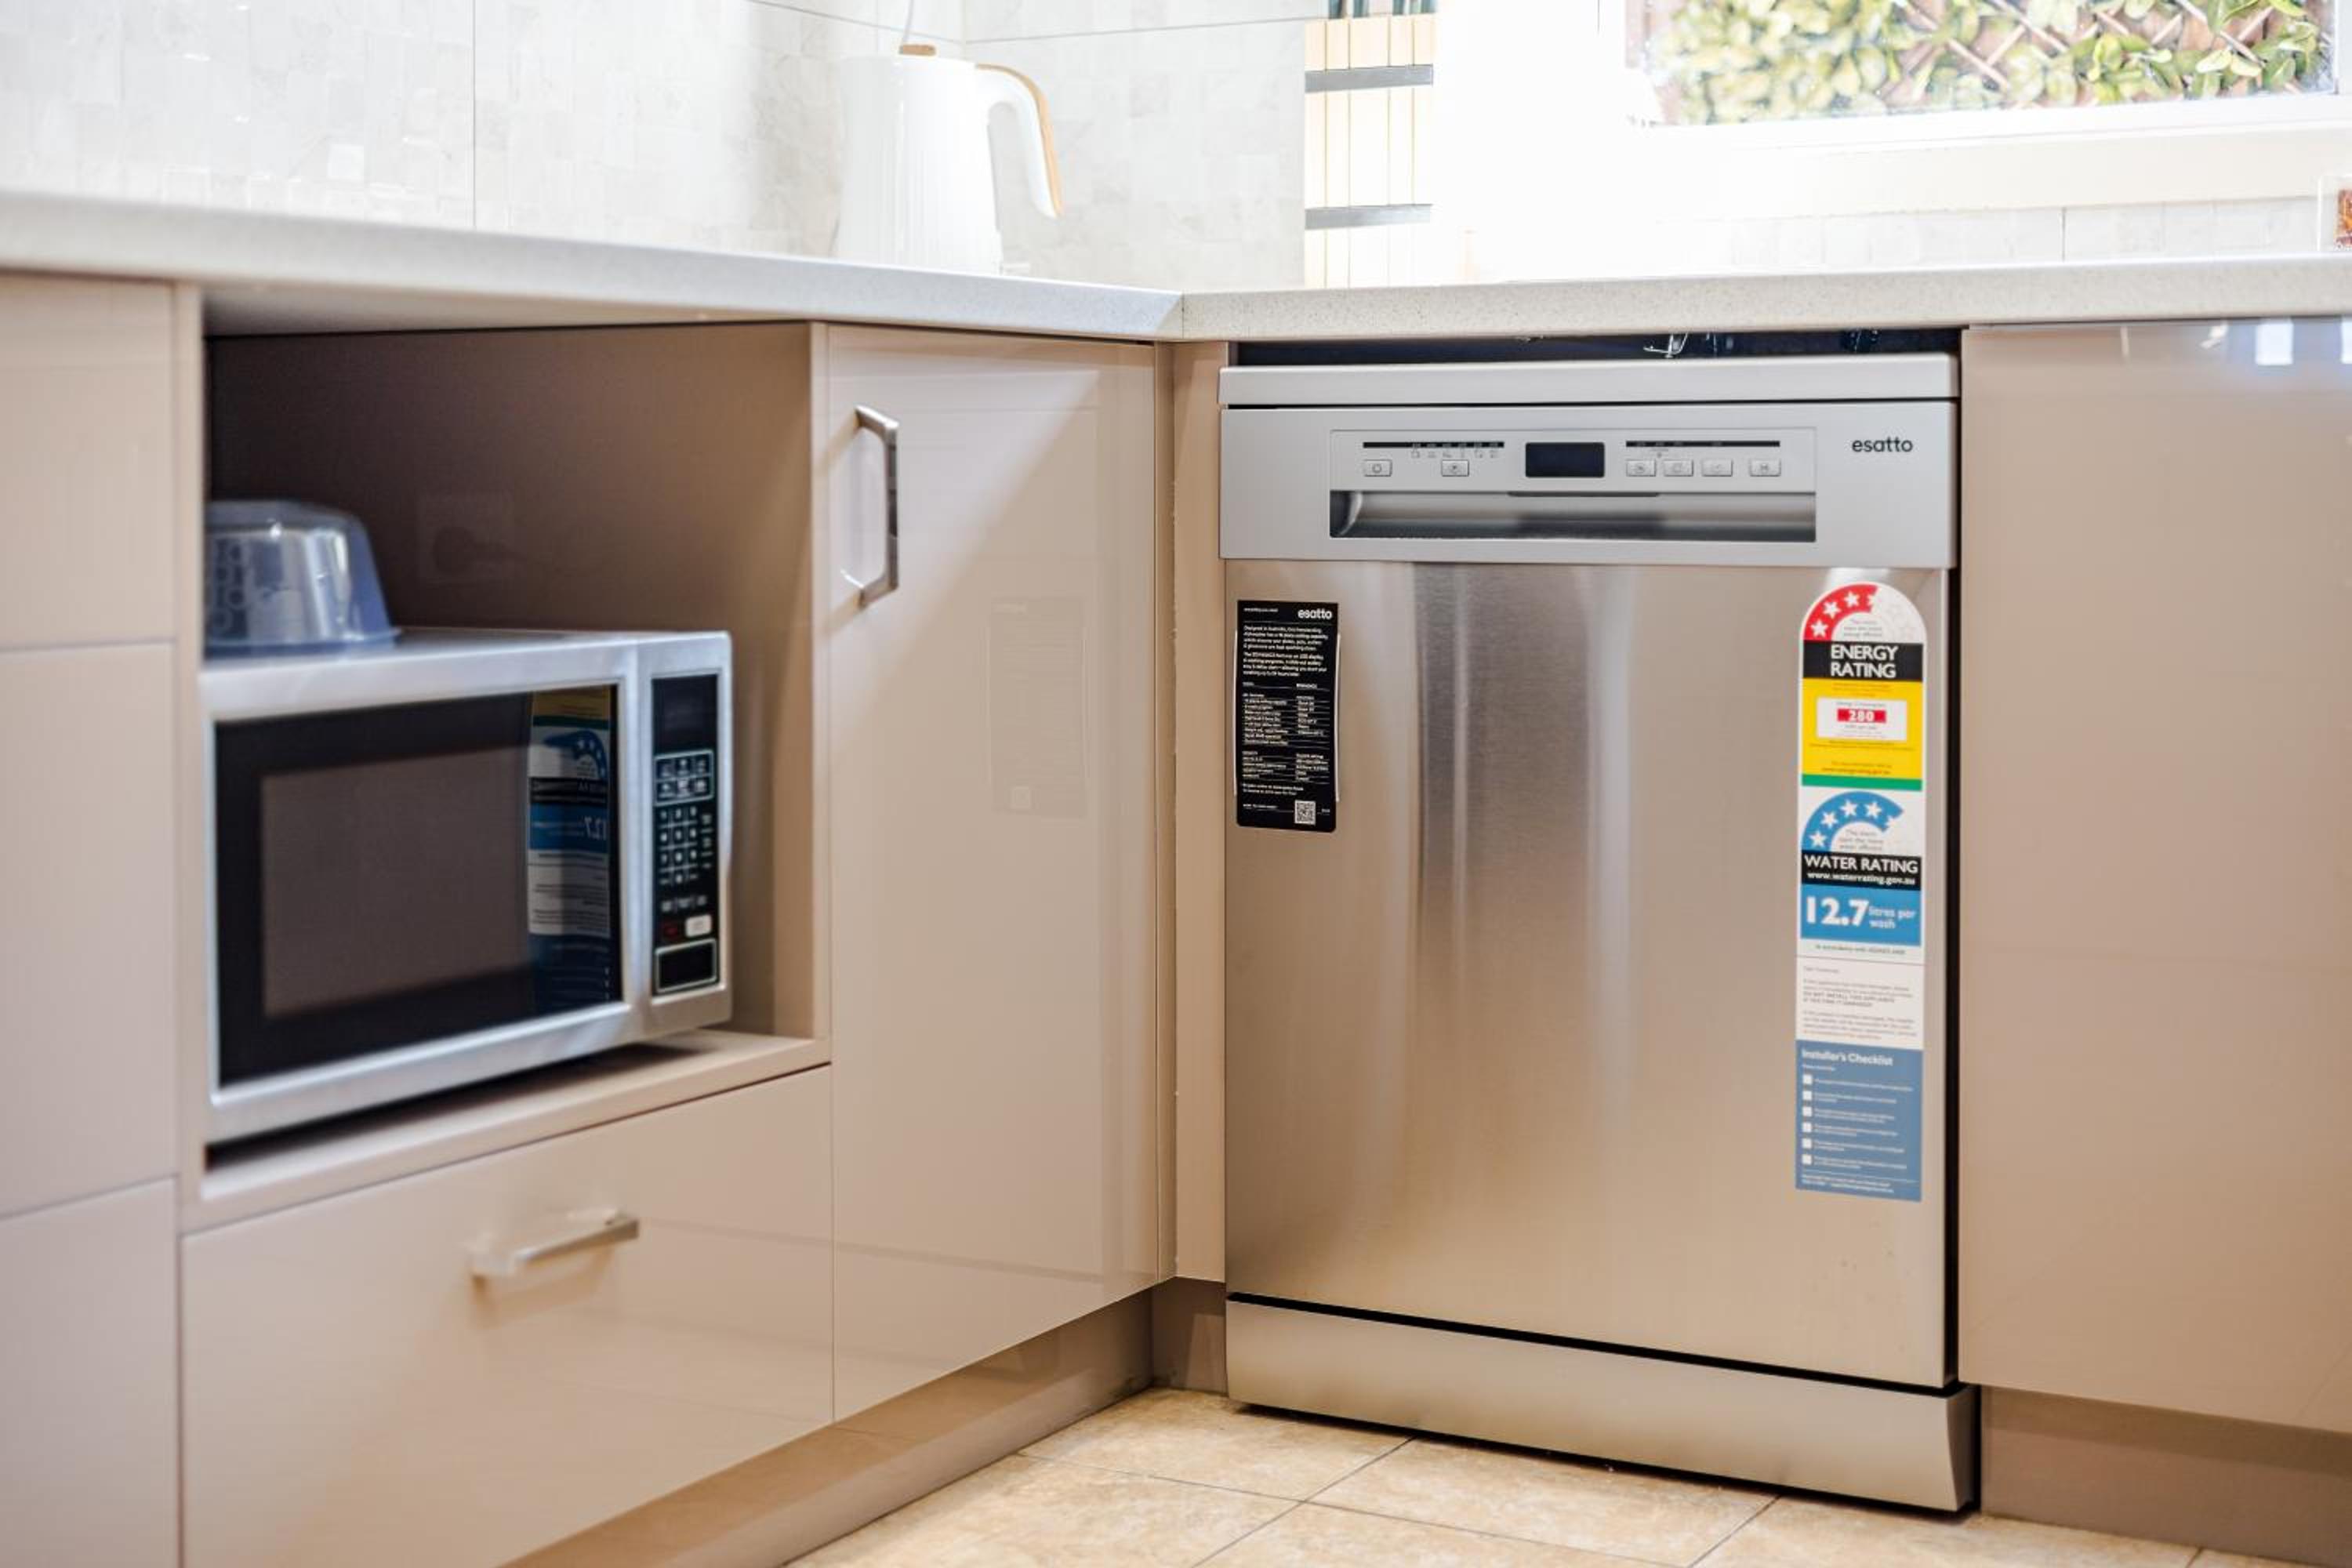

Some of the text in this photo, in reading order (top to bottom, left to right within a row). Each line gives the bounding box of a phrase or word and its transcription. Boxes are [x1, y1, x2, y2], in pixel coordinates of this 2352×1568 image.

[1852, 436, 1913, 452] esatto
[1298, 608, 1333, 619] esatto
[1831, 644, 1898, 661] ENERGY
[1831, 662, 1896, 678] RATING
[1848, 709, 1875, 722] 280
[1804, 855, 1918, 874] WATER RATING
[1807, 873, 1915, 886] www.waterrating.gov.au
[1806, 896, 1870, 926] 12.7
[1897, 910, 1916, 920] per
[1869, 918, 1896, 929] wash
[1848, 1054, 1893, 1067] Checklist
